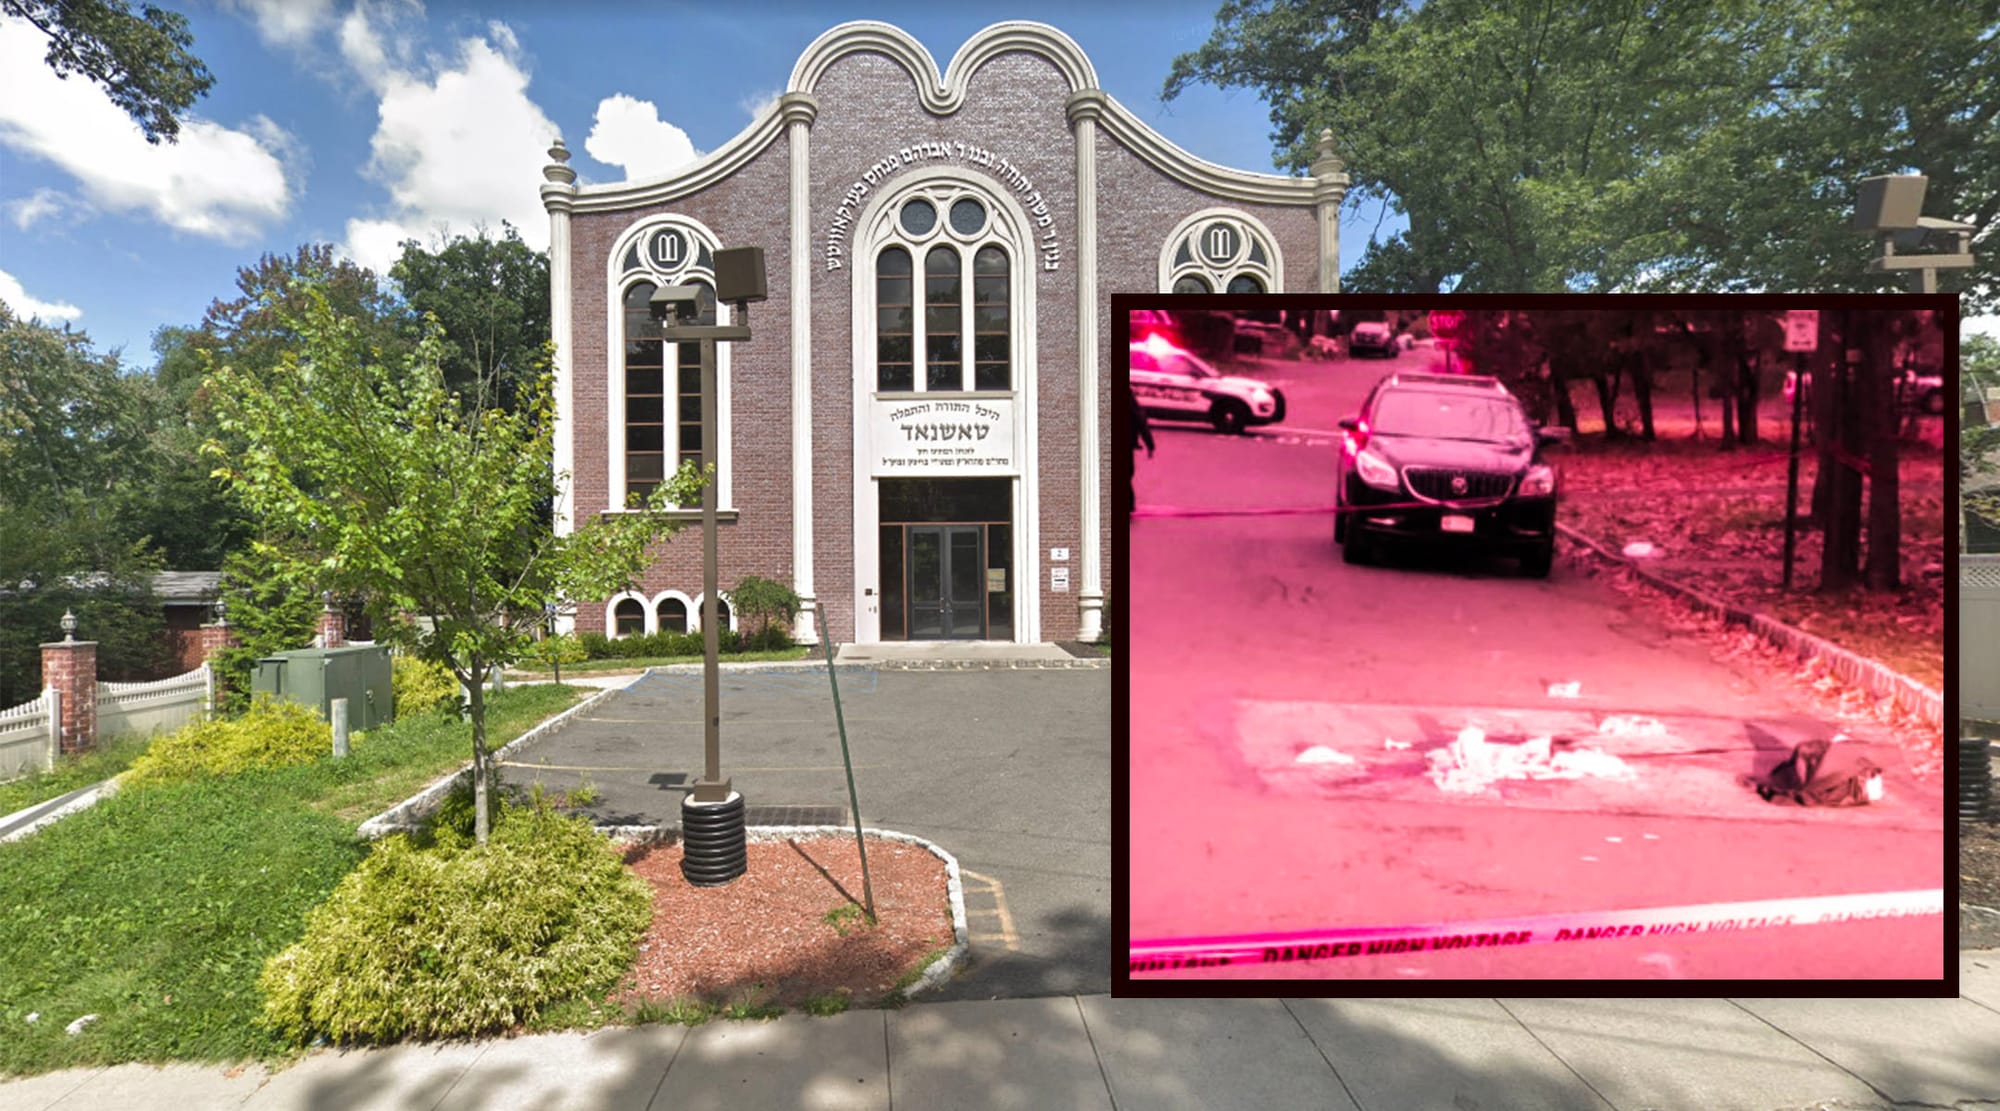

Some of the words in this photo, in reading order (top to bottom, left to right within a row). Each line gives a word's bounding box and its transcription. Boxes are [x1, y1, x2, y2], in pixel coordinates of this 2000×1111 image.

[900, 141, 951, 164] אברהם
[967, 145, 995, 167] ובנו
[863, 155, 899, 185] פנחס
[996, 159, 1032, 193] יהודה
[1026, 190, 1052, 227] משה
[1041, 242, 1060, 270] בנין
[890, 403, 930, 421] והתפלה
[935, 402, 970, 413] התורה
[975, 403, 1000, 421] היכל
[900, 422, 990, 441] טאשנאד
[1262, 943, 1361, 963] DANGER
[1365, 938, 1426, 957] HIGH
[1431, 931, 1532, 950] VOLTAGE
[1555, 924, 1644, 942] DANGER
[1645, 920, 1701, 937] HIGH
